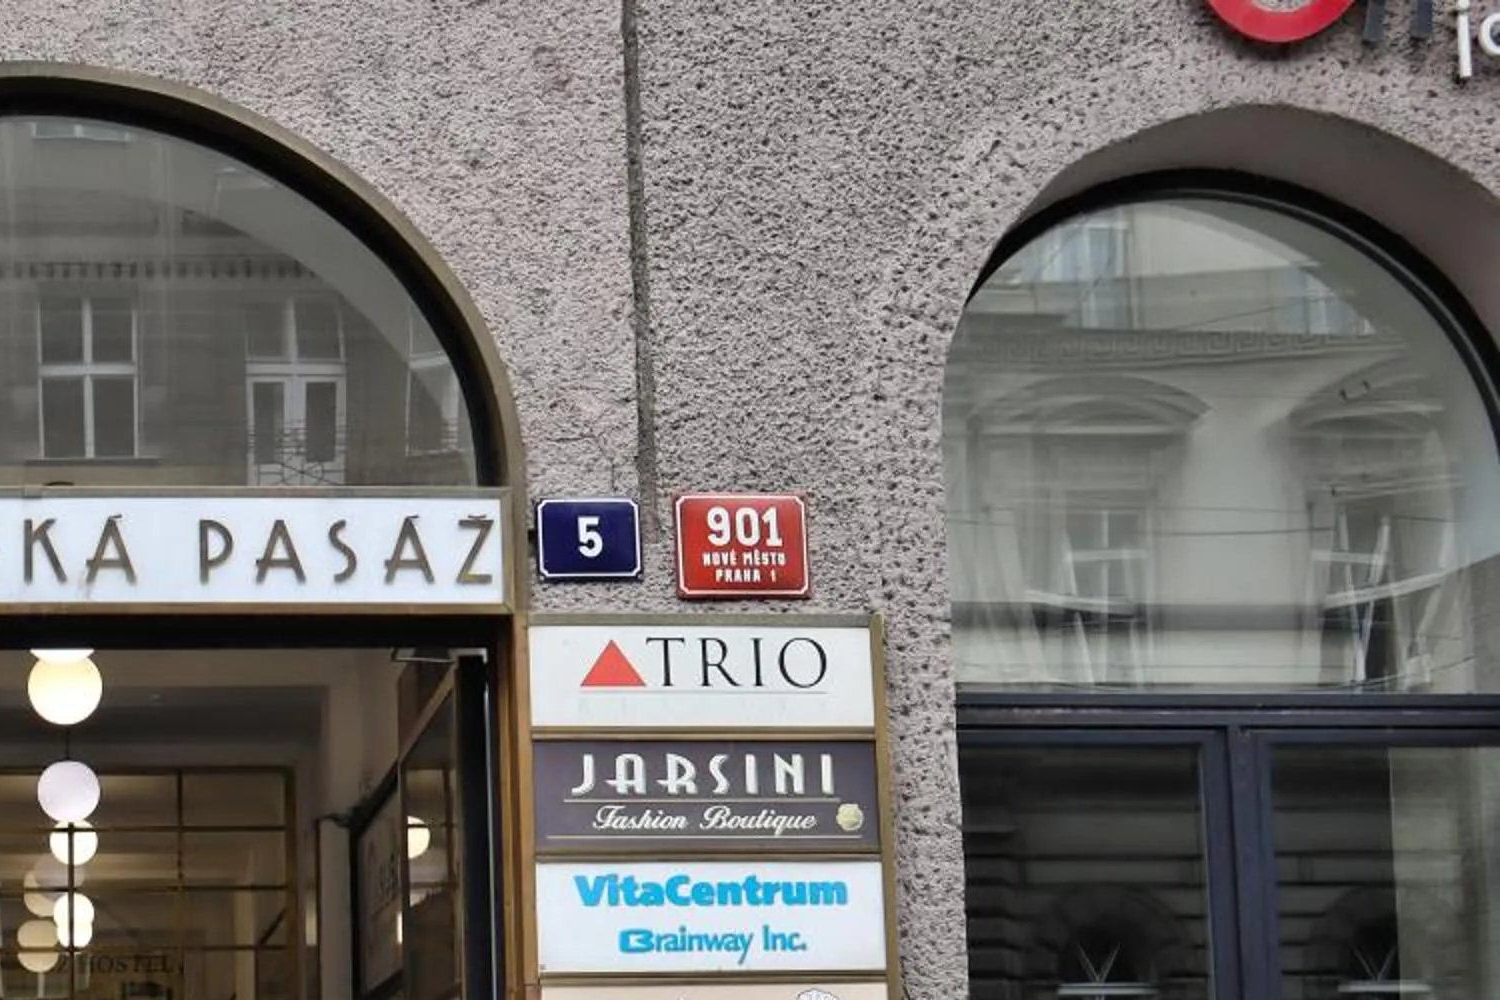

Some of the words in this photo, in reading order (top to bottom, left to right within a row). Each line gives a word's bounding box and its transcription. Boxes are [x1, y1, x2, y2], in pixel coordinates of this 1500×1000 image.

[577, 515, 604, 558] 5
[706, 506, 783, 547] 901
[197, 512, 496, 586] PASÁŽ
[702, 549, 737, 567] NOVÉ
[742, 548, 786, 566] MĚSTO
[715, 568, 762, 583] PRAHA
[770, 568, 777, 583] 1
[646, 637, 827, 689] TRIO
[571, 753, 835, 795] JARSINI
[592, 804, 688, 831] Fashion
[699, 804, 818, 837] Boutique
[573, 873, 849, 907] VitaCentrum
[618, 926, 755, 965] Brainway
[762, 925, 808, 952] Inc.
